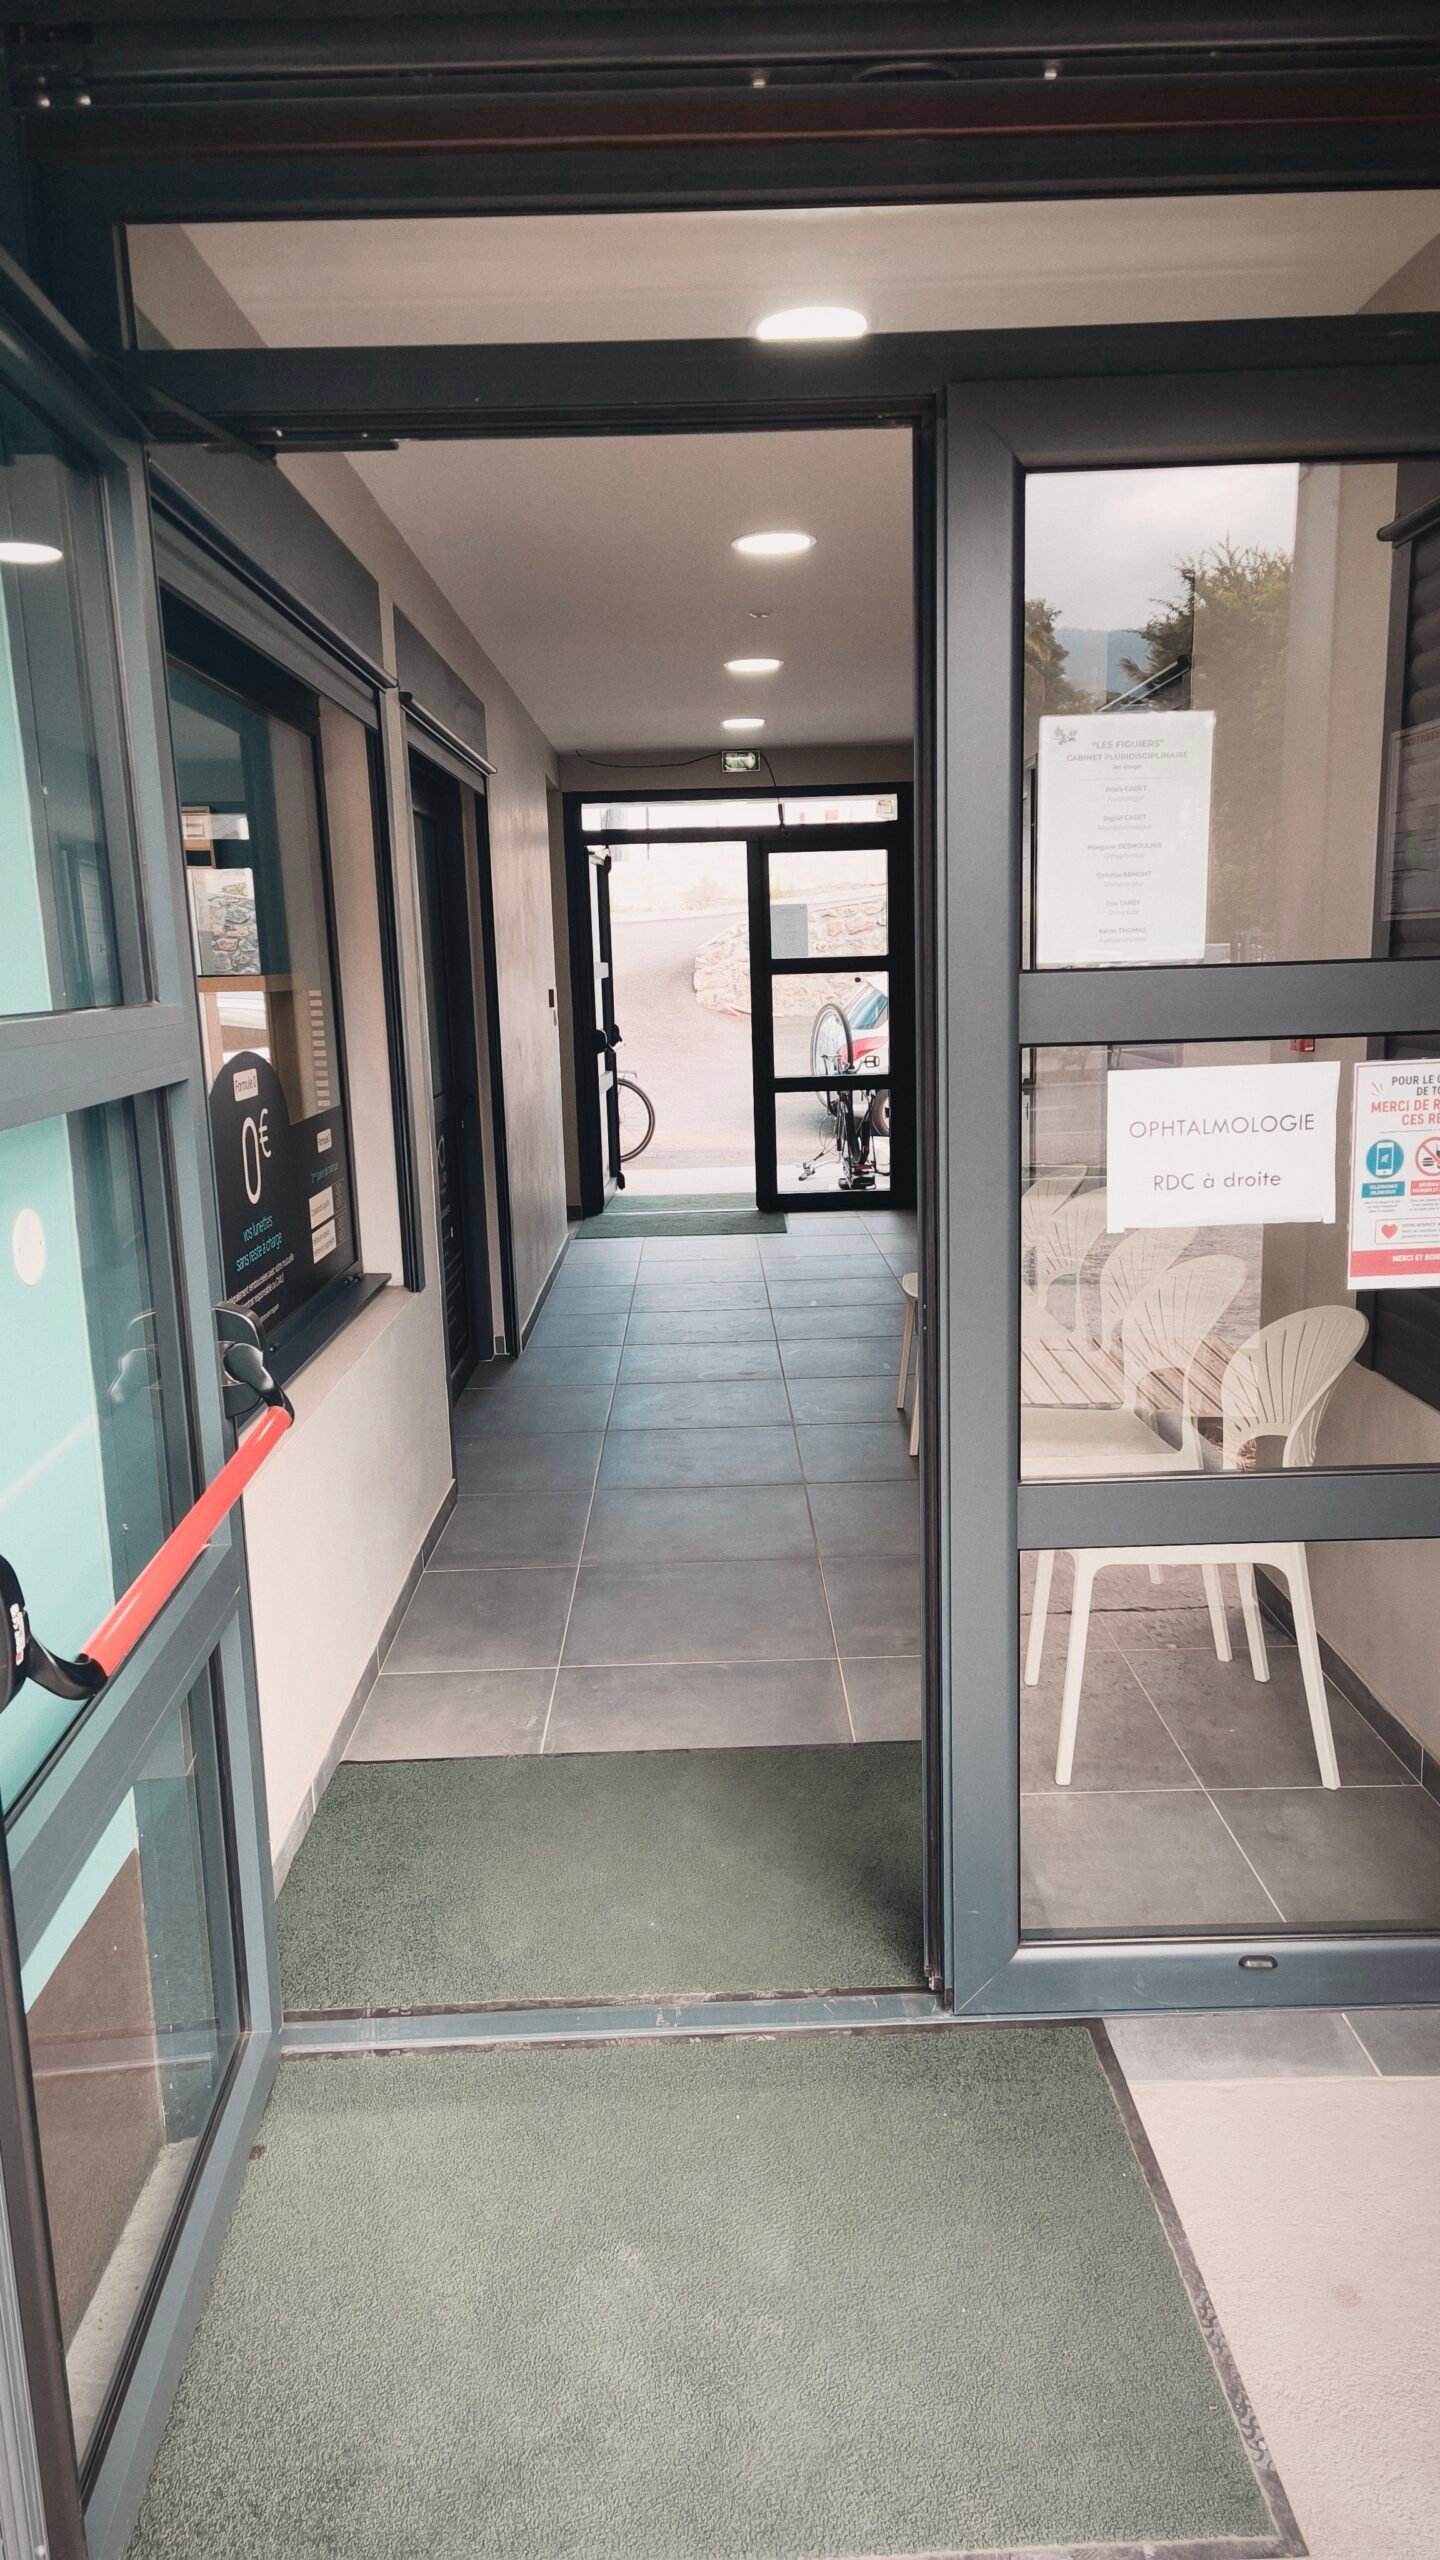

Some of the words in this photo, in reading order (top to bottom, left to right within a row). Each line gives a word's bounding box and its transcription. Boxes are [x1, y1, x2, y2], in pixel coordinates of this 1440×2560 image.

[1066, 753, 1102, 761] CABINET
[1104, 751, 1189, 760] PLURIDISCIPLINAIRE
[1391, 1075, 1420, 1086] POUR
[1423, 1074, 1434, 1085] LE
[1416, 1086, 1429, 1096] DE
[1371, 1100, 1410, 1113] MERCI
[1414, 1099, 1429, 1112] DE
[1129, 1113, 1315, 1139] OPHTALMOLOGIE
[1402, 1113, 1424, 1126] CES
[1153, 1173, 1195, 1192] RDC
[1203, 1172, 1215, 1189] à
[1223, 1170, 1282, 1188] droite
